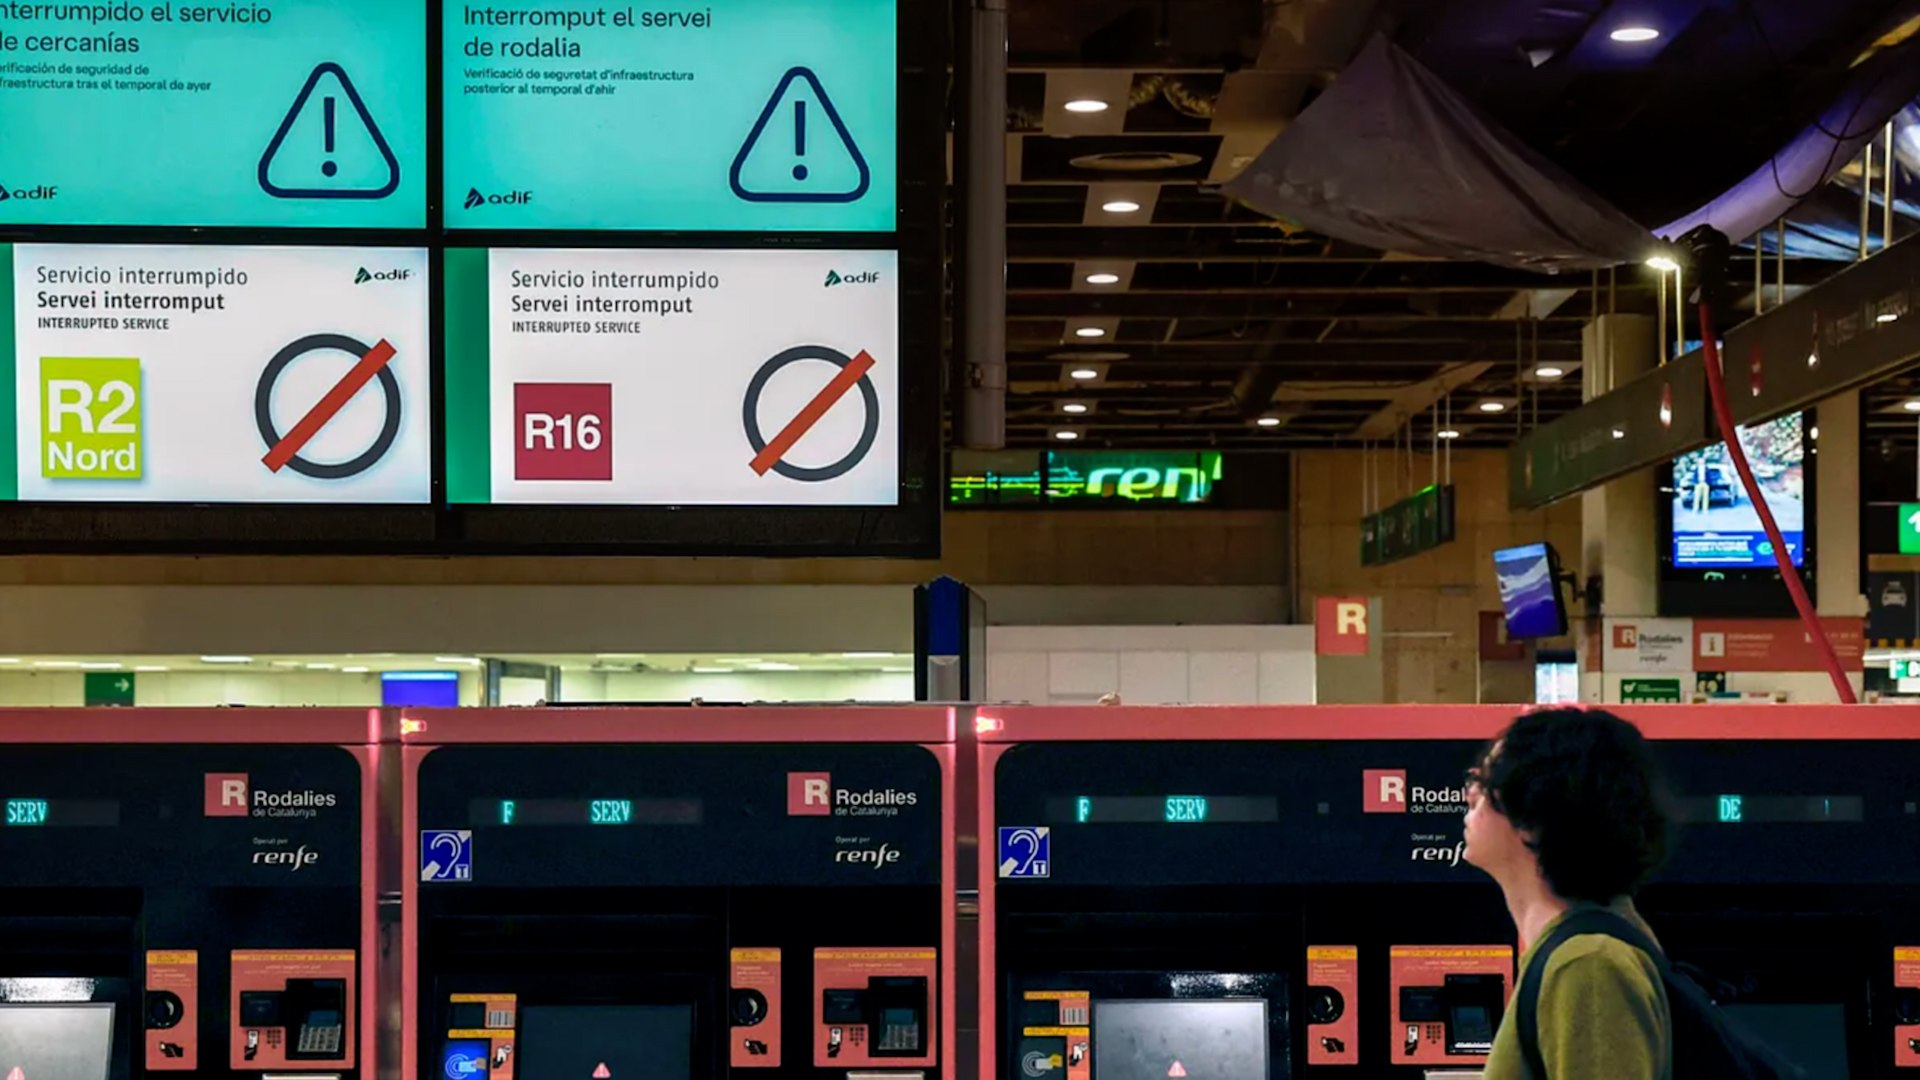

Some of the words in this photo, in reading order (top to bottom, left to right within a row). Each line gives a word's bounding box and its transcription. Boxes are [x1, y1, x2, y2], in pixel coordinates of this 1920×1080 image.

[151, 2, 173, 22] el
[180, 2, 272, 23] servicio
[463, 5, 606, 31] Interromput
[613, 7, 634, 27] el
[641, 8, 711, 28] servei
[0, 29, 18, 51] e
[25, 31, 139, 52] cercanías
[464, 37, 493, 57] de
[502, 38, 581, 58] rodalia
[58, 63, 73, 75] de
[75, 64, 132, 77] seguridad
[134, 65, 150, 76] de
[463, 67, 524, 80] Verificació
[526, 68, 541, 80] de
[543, 69, 597, 83] seguretat
[600, 68, 694, 82] d'infraestructura
[76, 78, 99, 90] tras
[101, 79, 112, 90] el
[115, 79, 167, 92] temporal
[169, 80, 185, 91] de
[186, 82, 212, 93] ayer
[463, 83, 515, 95] posterior
[518, 83, 528, 94] al
[531, 83, 583, 96] temporal
[584, 83, 616, 95] d'ahir
[12, 185, 58, 200] adif
[487, 190, 533, 205] adif
[36, 266, 112, 286] Servicio
[119, 266, 249, 287] interrumpido
[373, 269, 411, 282] adif
[511, 269, 585, 289] Servicio
[592, 270, 720, 291] interrumpido
[843, 271, 880, 284] adif
[37, 291, 97, 309] Servei
[103, 291, 226, 313] interromput
[511, 294, 569, 313] Servei
[575, 295, 693, 316] interromput
[38, 316, 119, 330] INTERRUPTED
[122, 317, 170, 331] SERVICE
[511, 320, 592, 334] INTERRUPTED
[595, 320, 641, 334] SERVICE
[47, 379, 137, 434] R2
[523, 412, 603, 451] R16
[47, 441, 137, 471] Nord
[1337, 603, 1367, 634] R
[222, 780, 246, 806] R
[253, 790, 336, 806] Rodalies
[804, 779, 829, 805] R
[835, 789, 917, 805] Rodalies
[1380, 776, 1405, 803] R
[7, 800, 47, 823] SERV
[252, 808, 265, 817] de
[267, 807, 317, 818] Catalunya
[503, 802, 514, 824] F
[592, 800, 630, 822] SERV
[835, 807, 847, 816] de
[849, 806, 898, 817] Catalunya
[1079, 799, 1090, 822] F
[1166, 798, 1206, 821] SERV
[1410, 804, 1423, 813] de
[1720, 797, 1742, 821] DE
[252, 844, 319, 872] renfe
[835, 843, 900, 870] renfe
